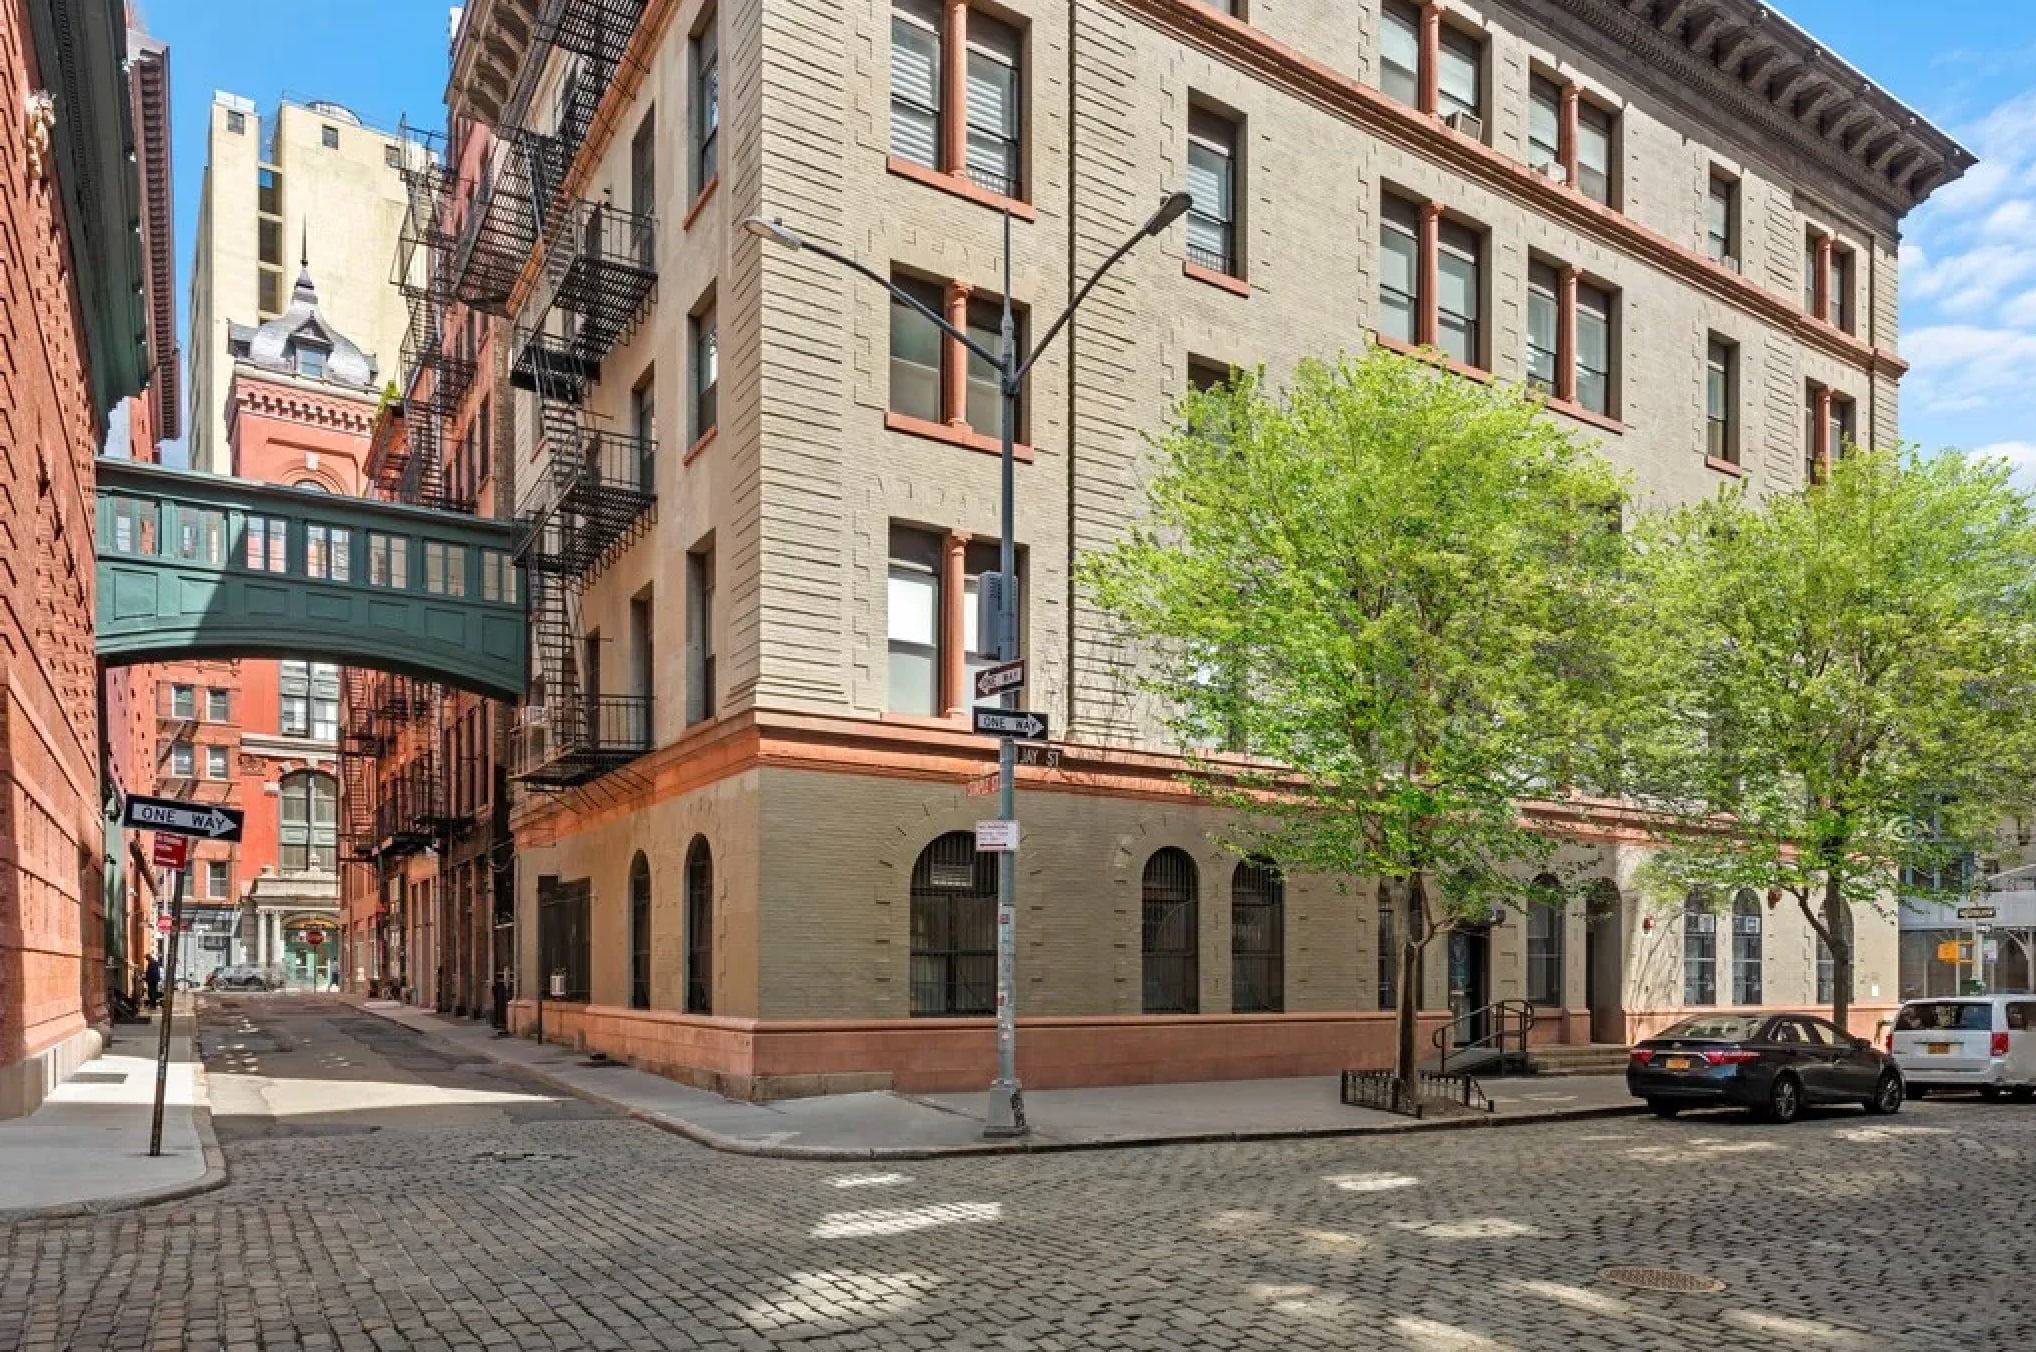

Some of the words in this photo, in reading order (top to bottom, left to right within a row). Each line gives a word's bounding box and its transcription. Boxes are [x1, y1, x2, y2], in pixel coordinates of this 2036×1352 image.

[984, 716, 1006, 728] ONE
[1016, 721, 1037, 731] WAY
[141, 807, 176, 823] ONE
[192, 813, 225, 830] WAY
